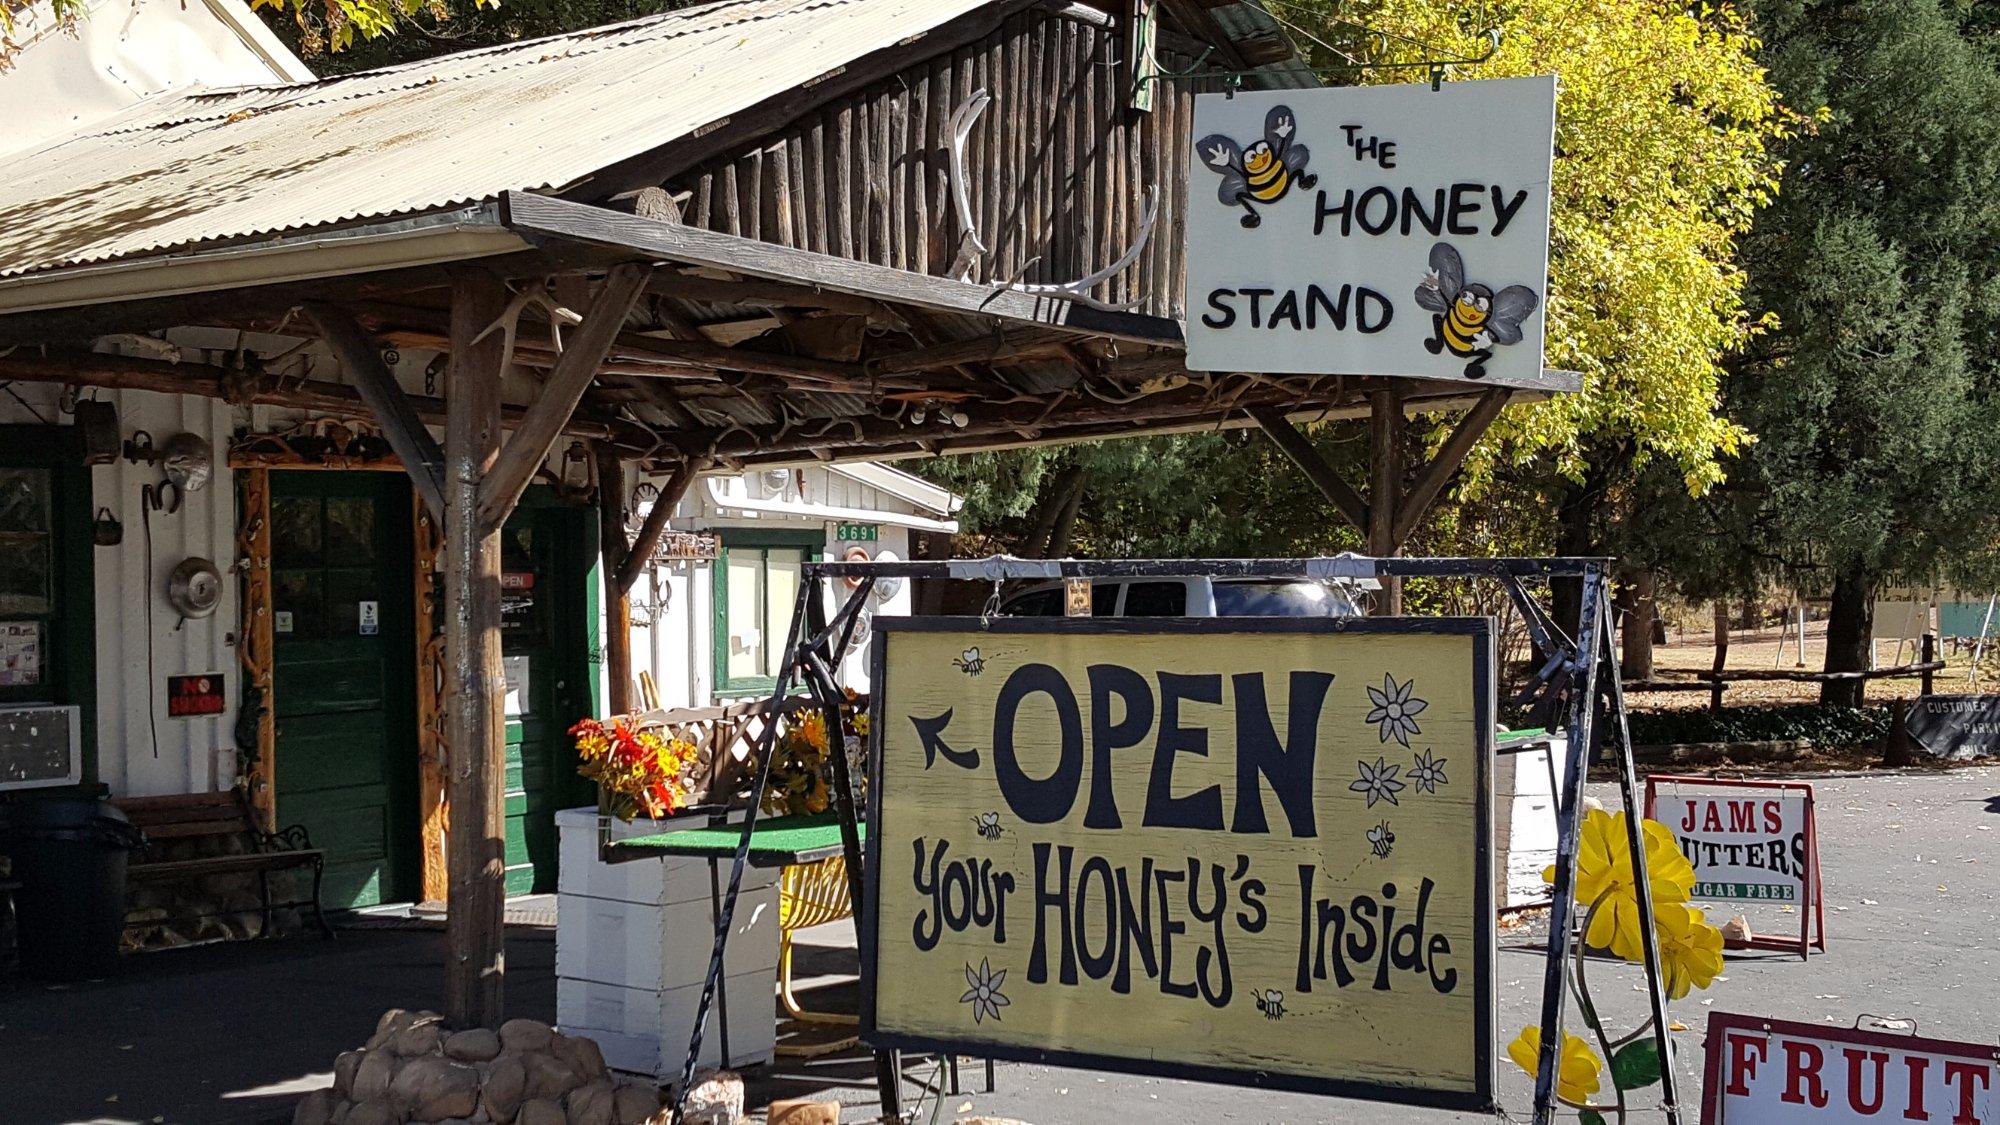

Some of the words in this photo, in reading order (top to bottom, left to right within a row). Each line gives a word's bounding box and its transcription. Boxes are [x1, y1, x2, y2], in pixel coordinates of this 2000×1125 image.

[1339, 124, 1397, 169] THE
[1313, 183, 1528, 237] HONEY
[1201, 283, 1394, 334] STAND
[839, 525, 876, 540] 3691
[501, 575, 524, 587] PEN
[1927, 701, 1987, 714] CUSTOMER
[1963, 722, 2000, 734] PARKI
[993, 662, 1336, 838] OPEN
[1681, 800, 1783, 834] JAMS
[1673, 832, 1803, 881] UTTERS
[1692, 882, 1737, 897] UGAR
[1746, 885, 1793, 899] FREE
[1295, 864, 1459, 994] Inside
[1726, 1033, 1991, 1125] FRUIT
